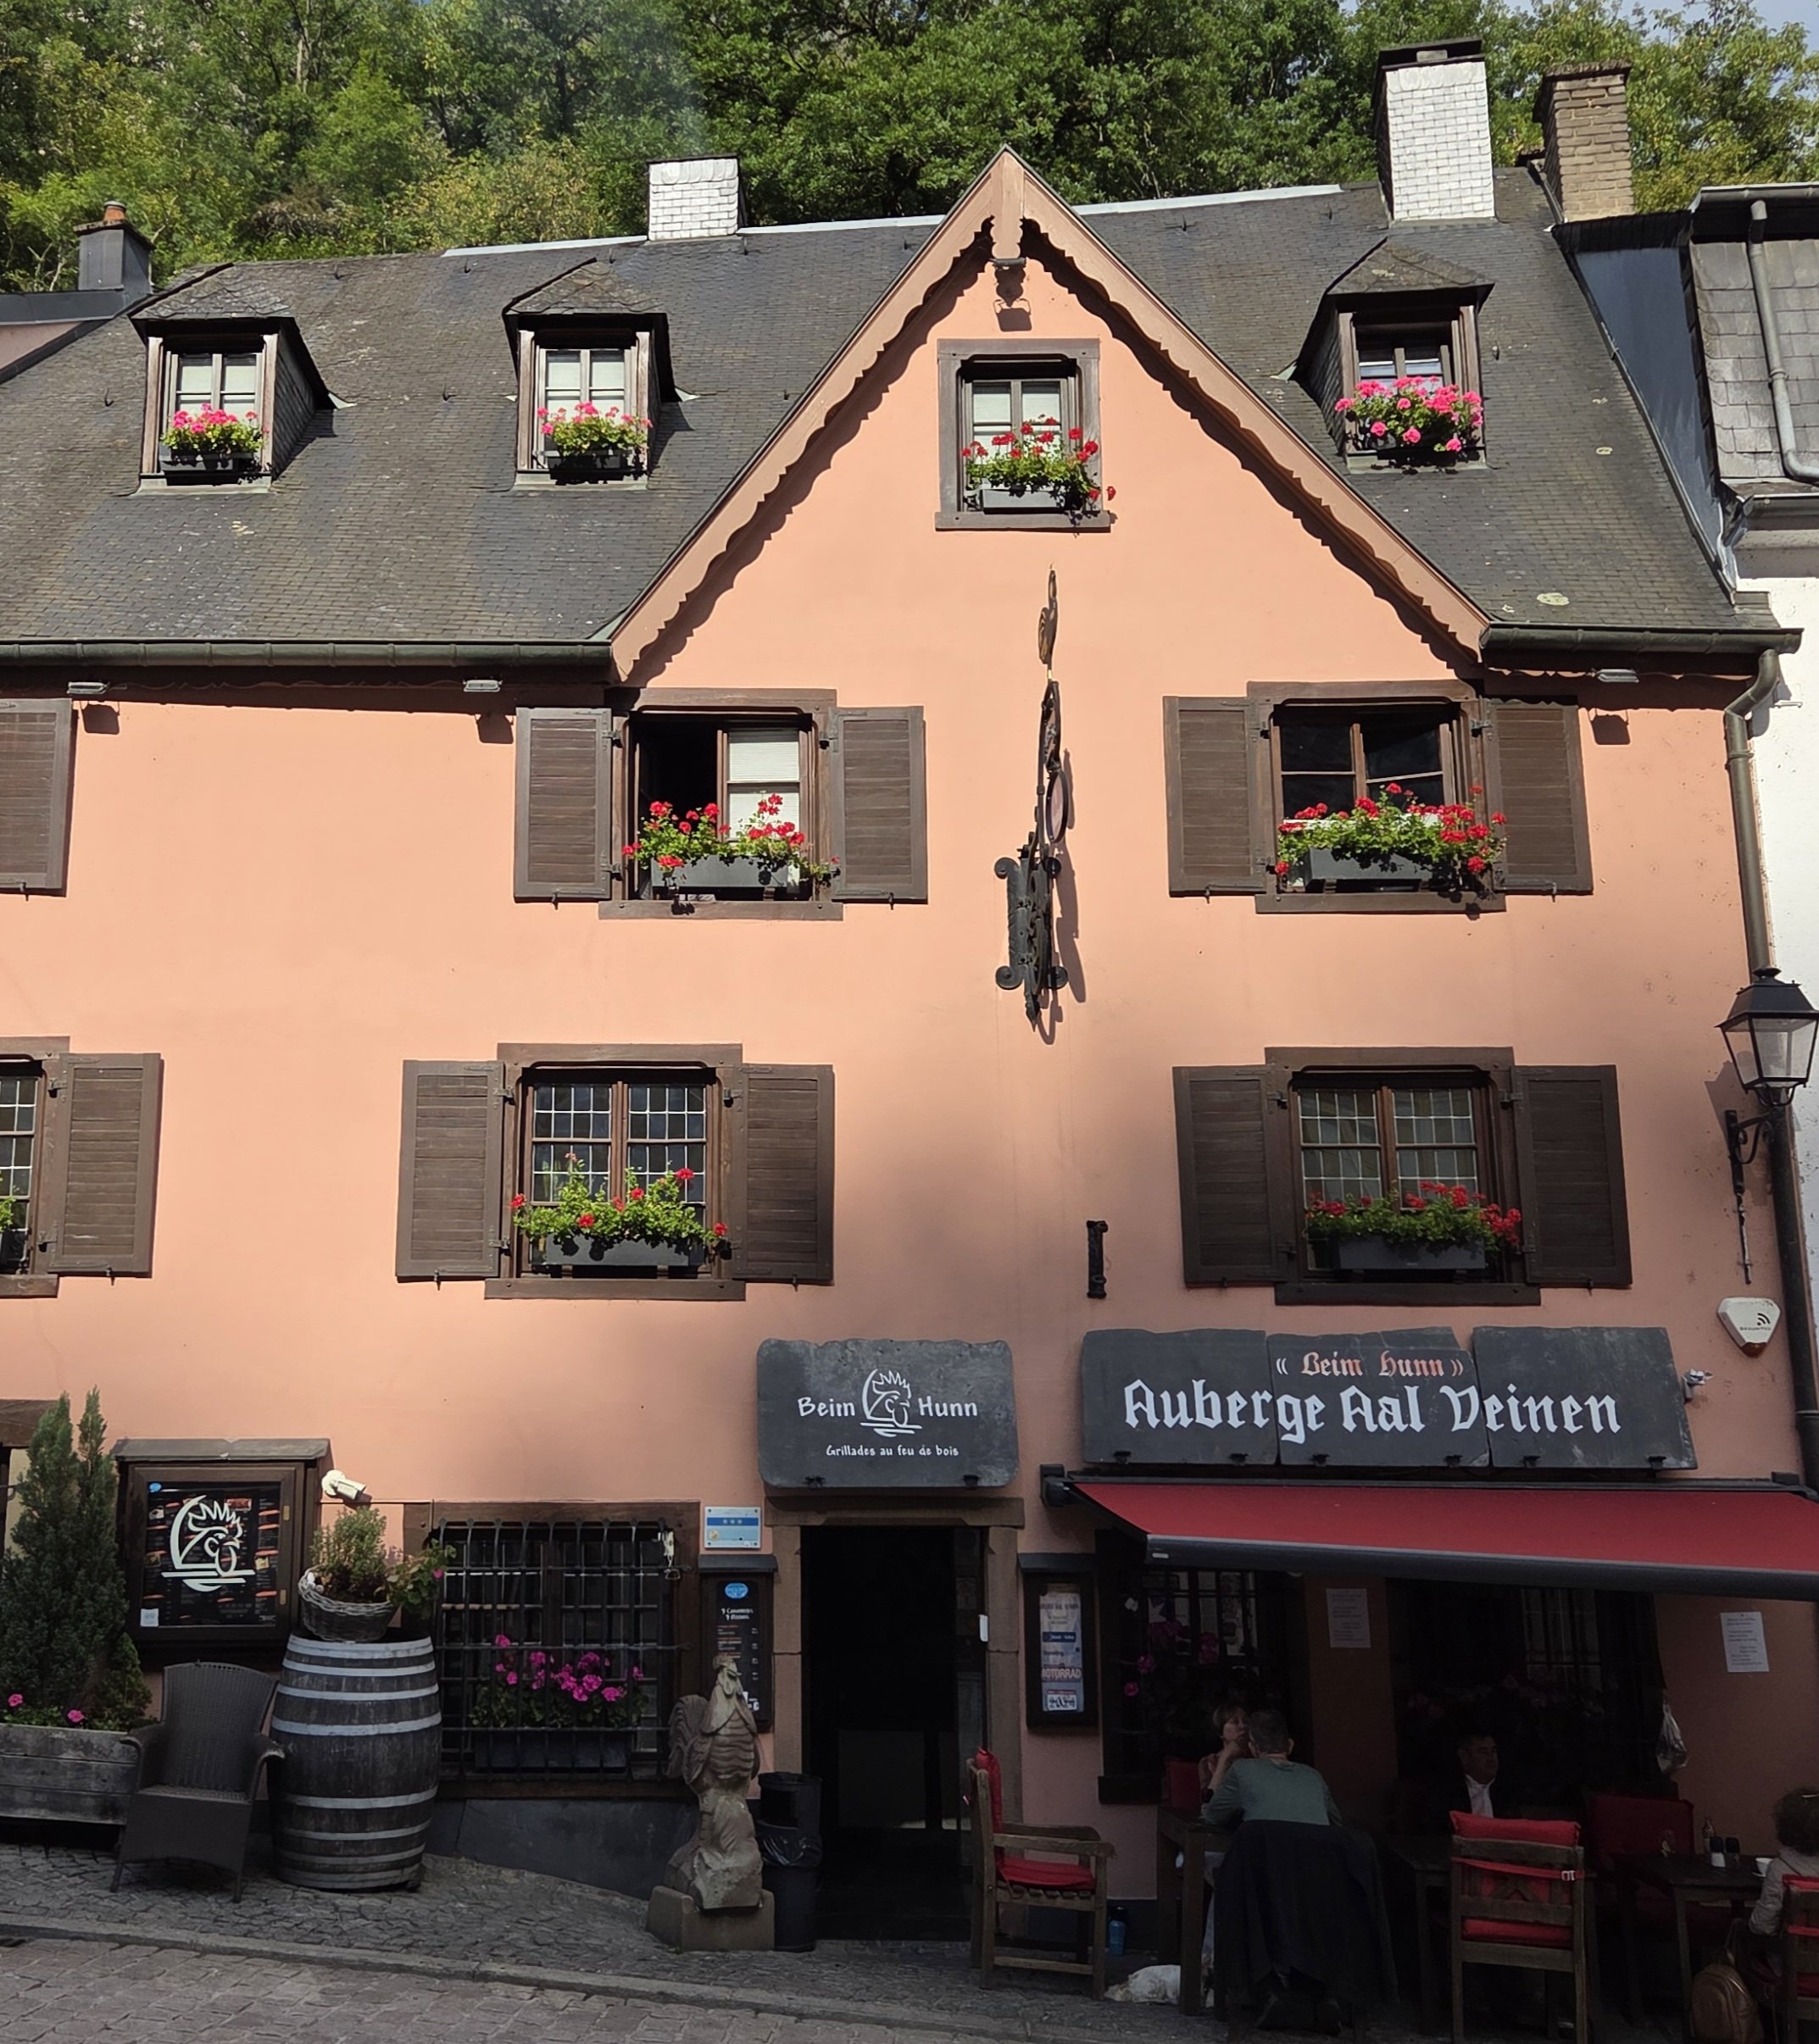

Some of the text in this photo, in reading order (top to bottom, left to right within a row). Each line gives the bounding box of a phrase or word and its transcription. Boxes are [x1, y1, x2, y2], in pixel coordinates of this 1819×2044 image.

[798, 1395, 978, 1417] Beim Hunn
[1123, 1378, 1622, 1444] Auberge Aal Veinen
[826, 1444, 960, 1457] Grillades au feu de bois
